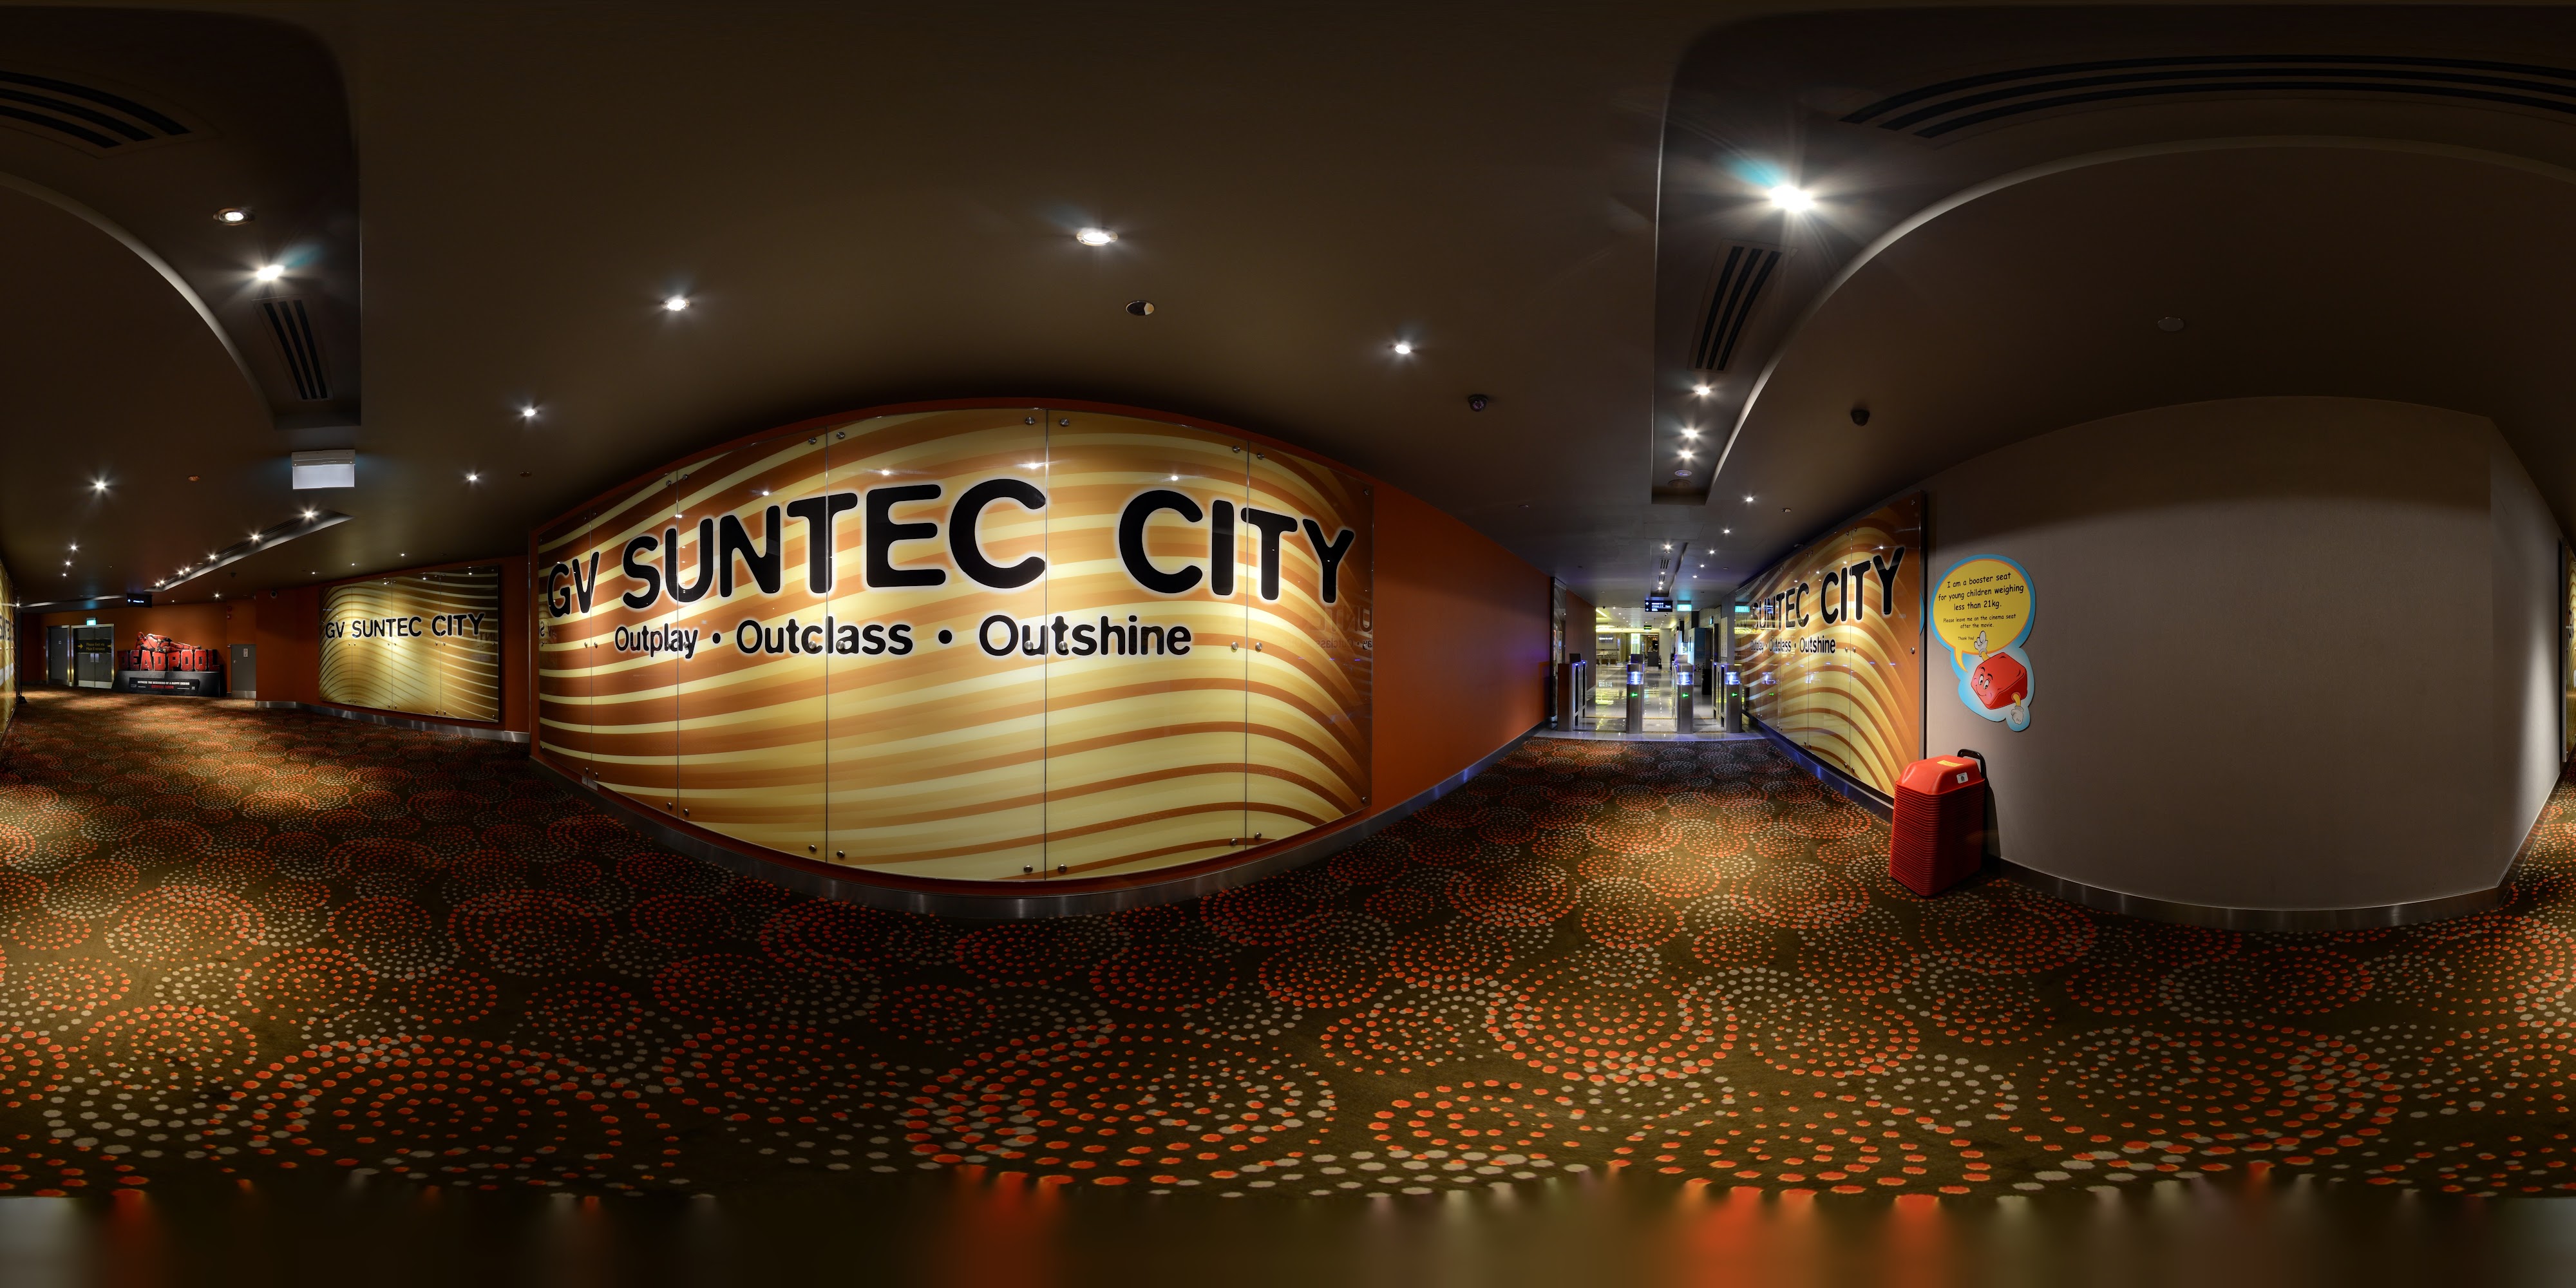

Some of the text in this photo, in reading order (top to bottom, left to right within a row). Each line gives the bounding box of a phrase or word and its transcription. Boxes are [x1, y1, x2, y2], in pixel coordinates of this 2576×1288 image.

[547, 478, 1354, 618] GV SUNTEC CITY
[1752, 546, 1905, 630] SUNTEC CITY
[1969, 576, 1993, 585] booster
[1996, 572, 2011, 581] seat
[1949, 592, 1965, 601] young
[1967, 589, 1992, 597] children
[1994, 584, 2024, 595] weighing
[1984, 600, 2002, 609] 21kg.
[325, 613, 485, 638] GV SUNTEC CITY
[614, 614, 1191, 659] Outplay Outclass Outshine
[1769, 638, 1792, 653] Outclass
[1799, 635, 1835, 654] Outshine
[117, 649, 220, 671] DEADPOOL
